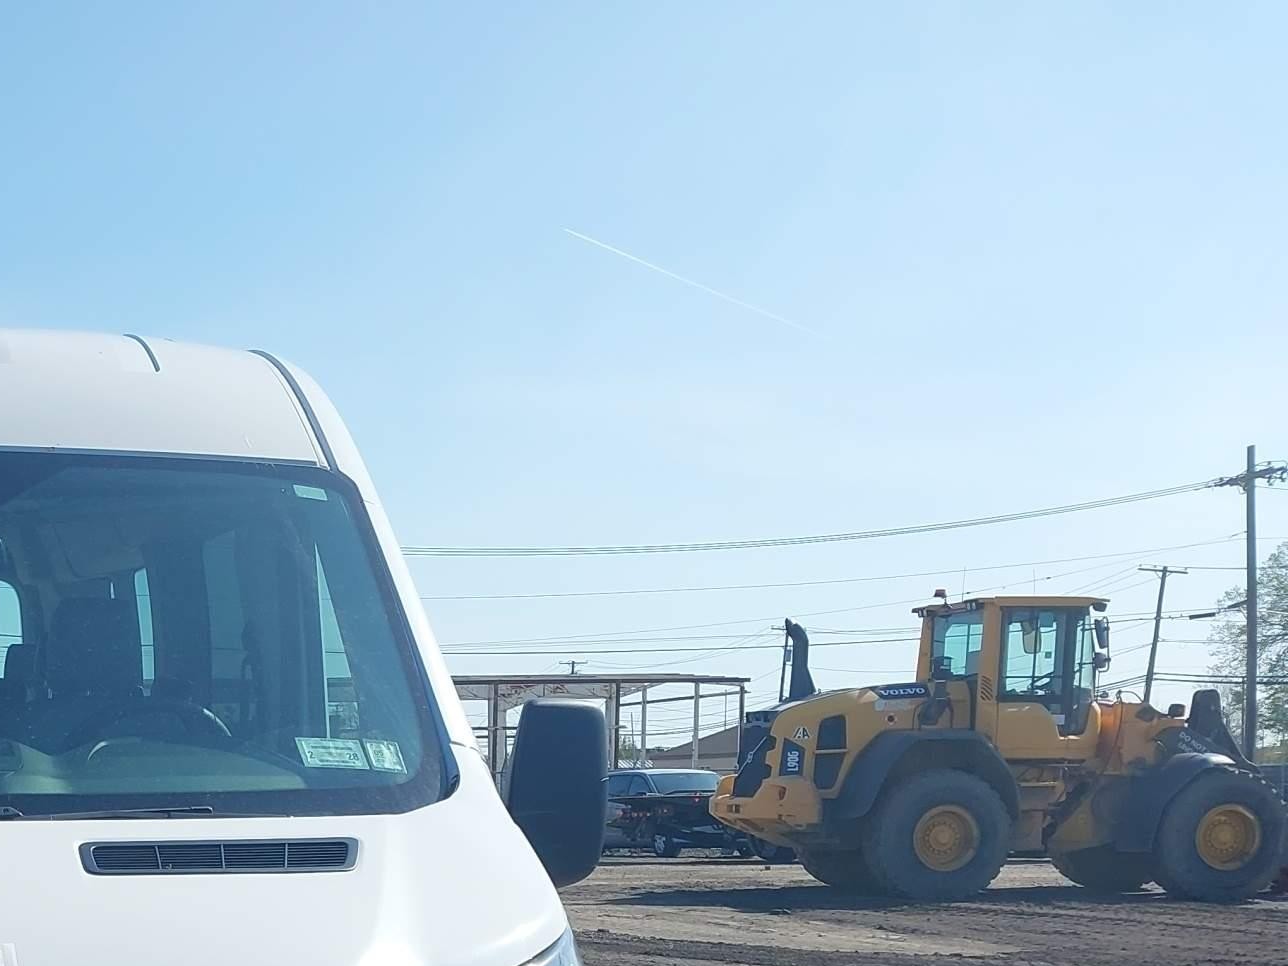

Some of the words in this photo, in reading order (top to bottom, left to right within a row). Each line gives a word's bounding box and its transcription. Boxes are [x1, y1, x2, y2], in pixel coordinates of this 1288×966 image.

[879, 687, 925, 696] VOLVO
[307, 750, 316, 759] 2
[346, 752, 359, 761] 28
[786, 751, 799, 772] L90G
